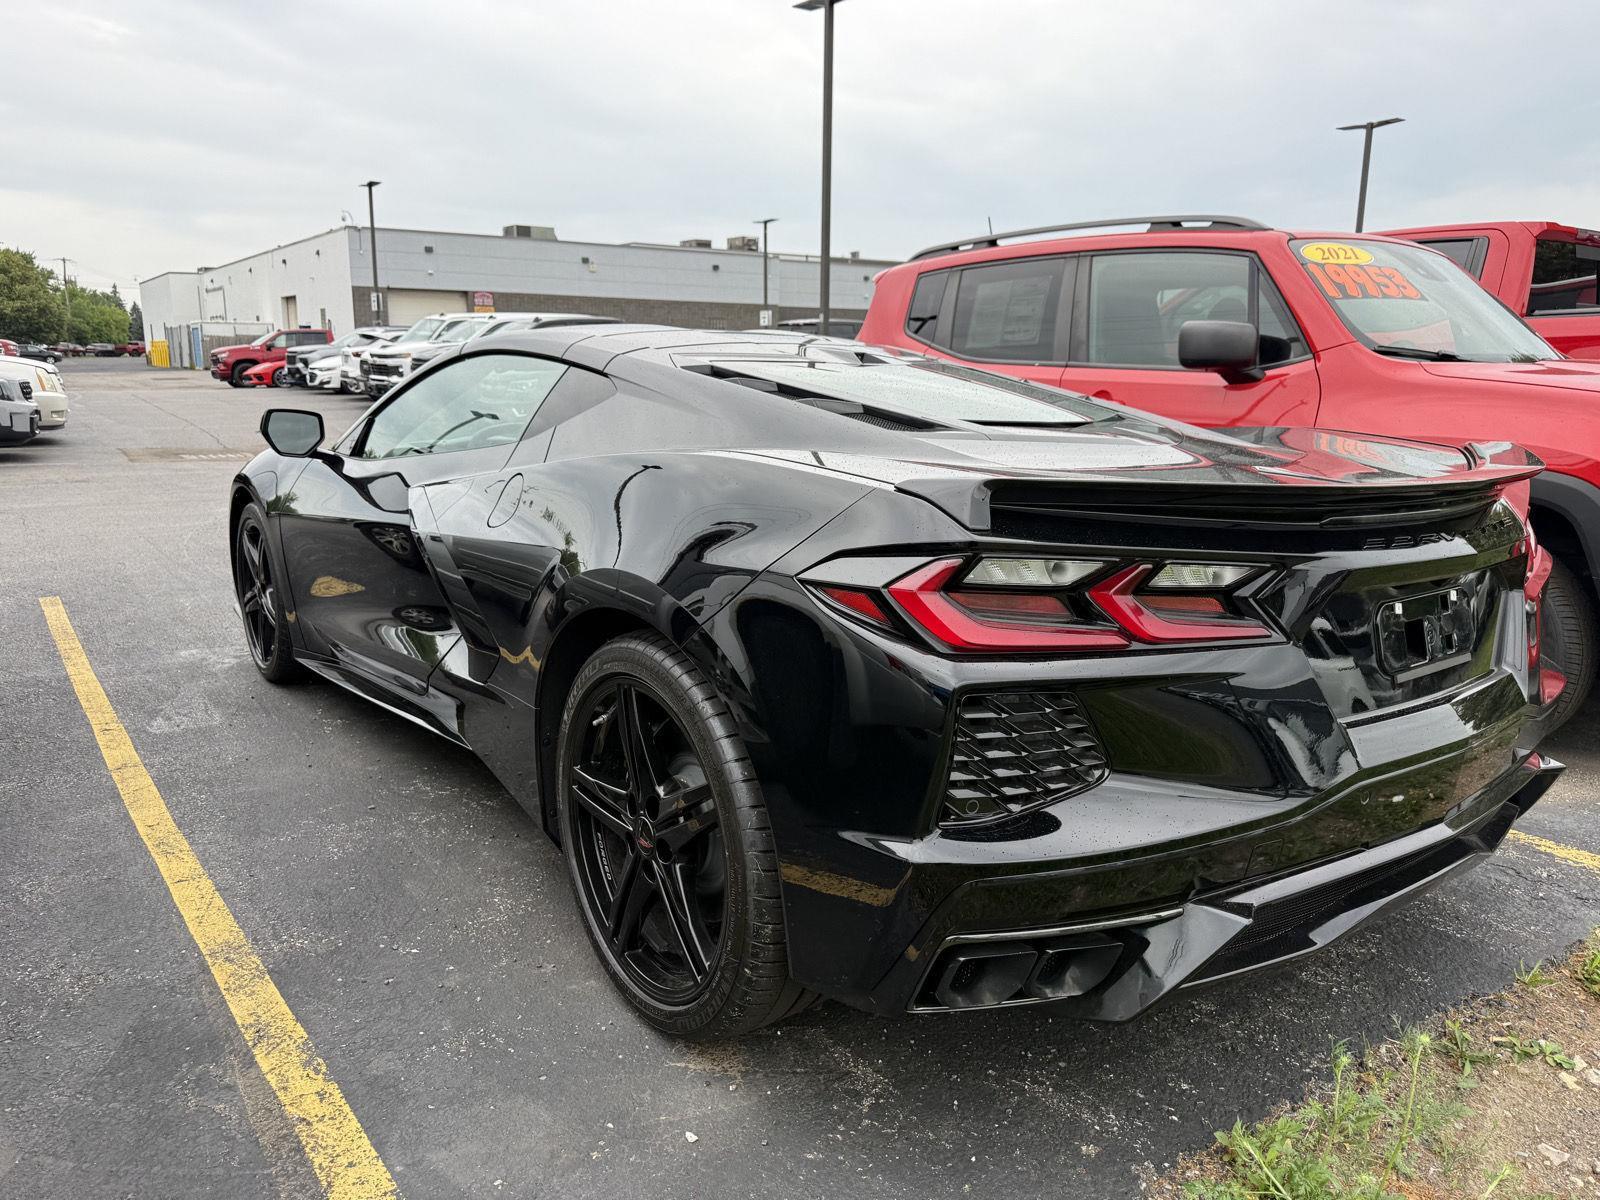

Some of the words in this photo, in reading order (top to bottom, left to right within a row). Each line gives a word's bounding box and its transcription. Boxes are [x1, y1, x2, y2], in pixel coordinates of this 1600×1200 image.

[1315, 247, 1359, 260] 2021
[1307, 264, 1421, 298] 19953
[597, 832, 611, 880] FORGED
